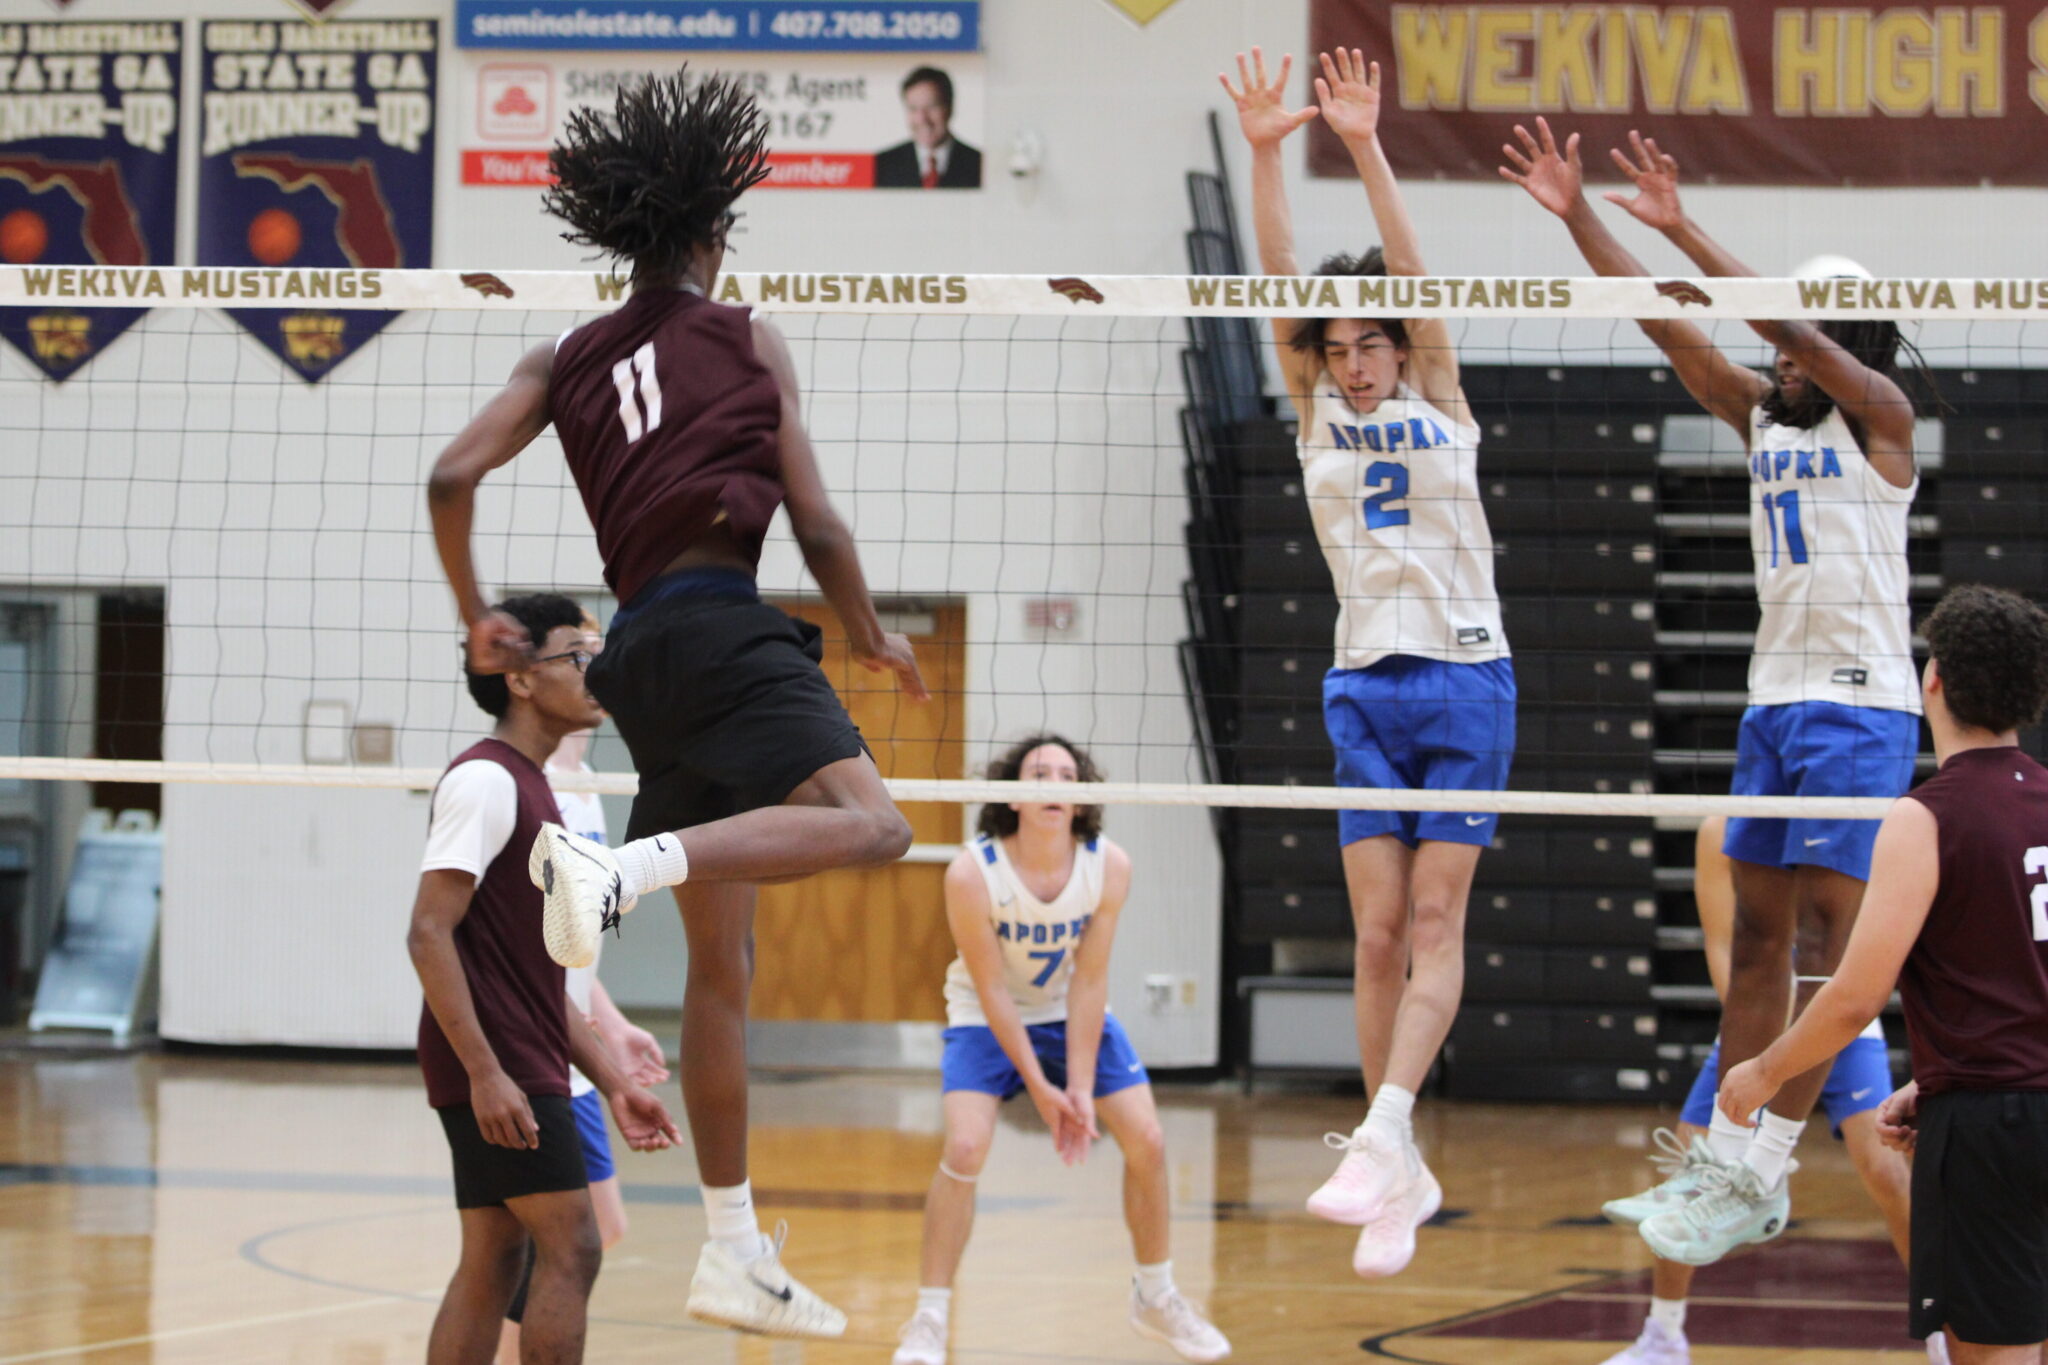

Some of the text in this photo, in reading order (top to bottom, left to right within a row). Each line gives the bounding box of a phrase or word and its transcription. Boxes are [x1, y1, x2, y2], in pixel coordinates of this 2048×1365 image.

[472, 11, 961, 39] seminolestate.edu 407.708.2050
[213, 54, 356, 90] STATE
[1394, 6, 1752, 115] WEKIVA
[1774, 6, 2005, 117] HIGH
[785, 73, 866, 104] Agent
[203, 91, 432, 156] RUNNER-UP
[22, 269, 383, 299] WEKIVA MUSTANGS
[760, 274, 968, 304] MUSTANGS
[1187, 278, 1572, 308] WEKIVA MUSTANGS
[1797, 280, 1956, 309] WEKIVA
[612, 340, 662, 445] 11
[1327, 417, 1449, 453] APOPKA
[1363, 461, 1410, 531] 2
[1761, 489, 1808, 568] 11
[1027, 948, 1066, 987] 7
